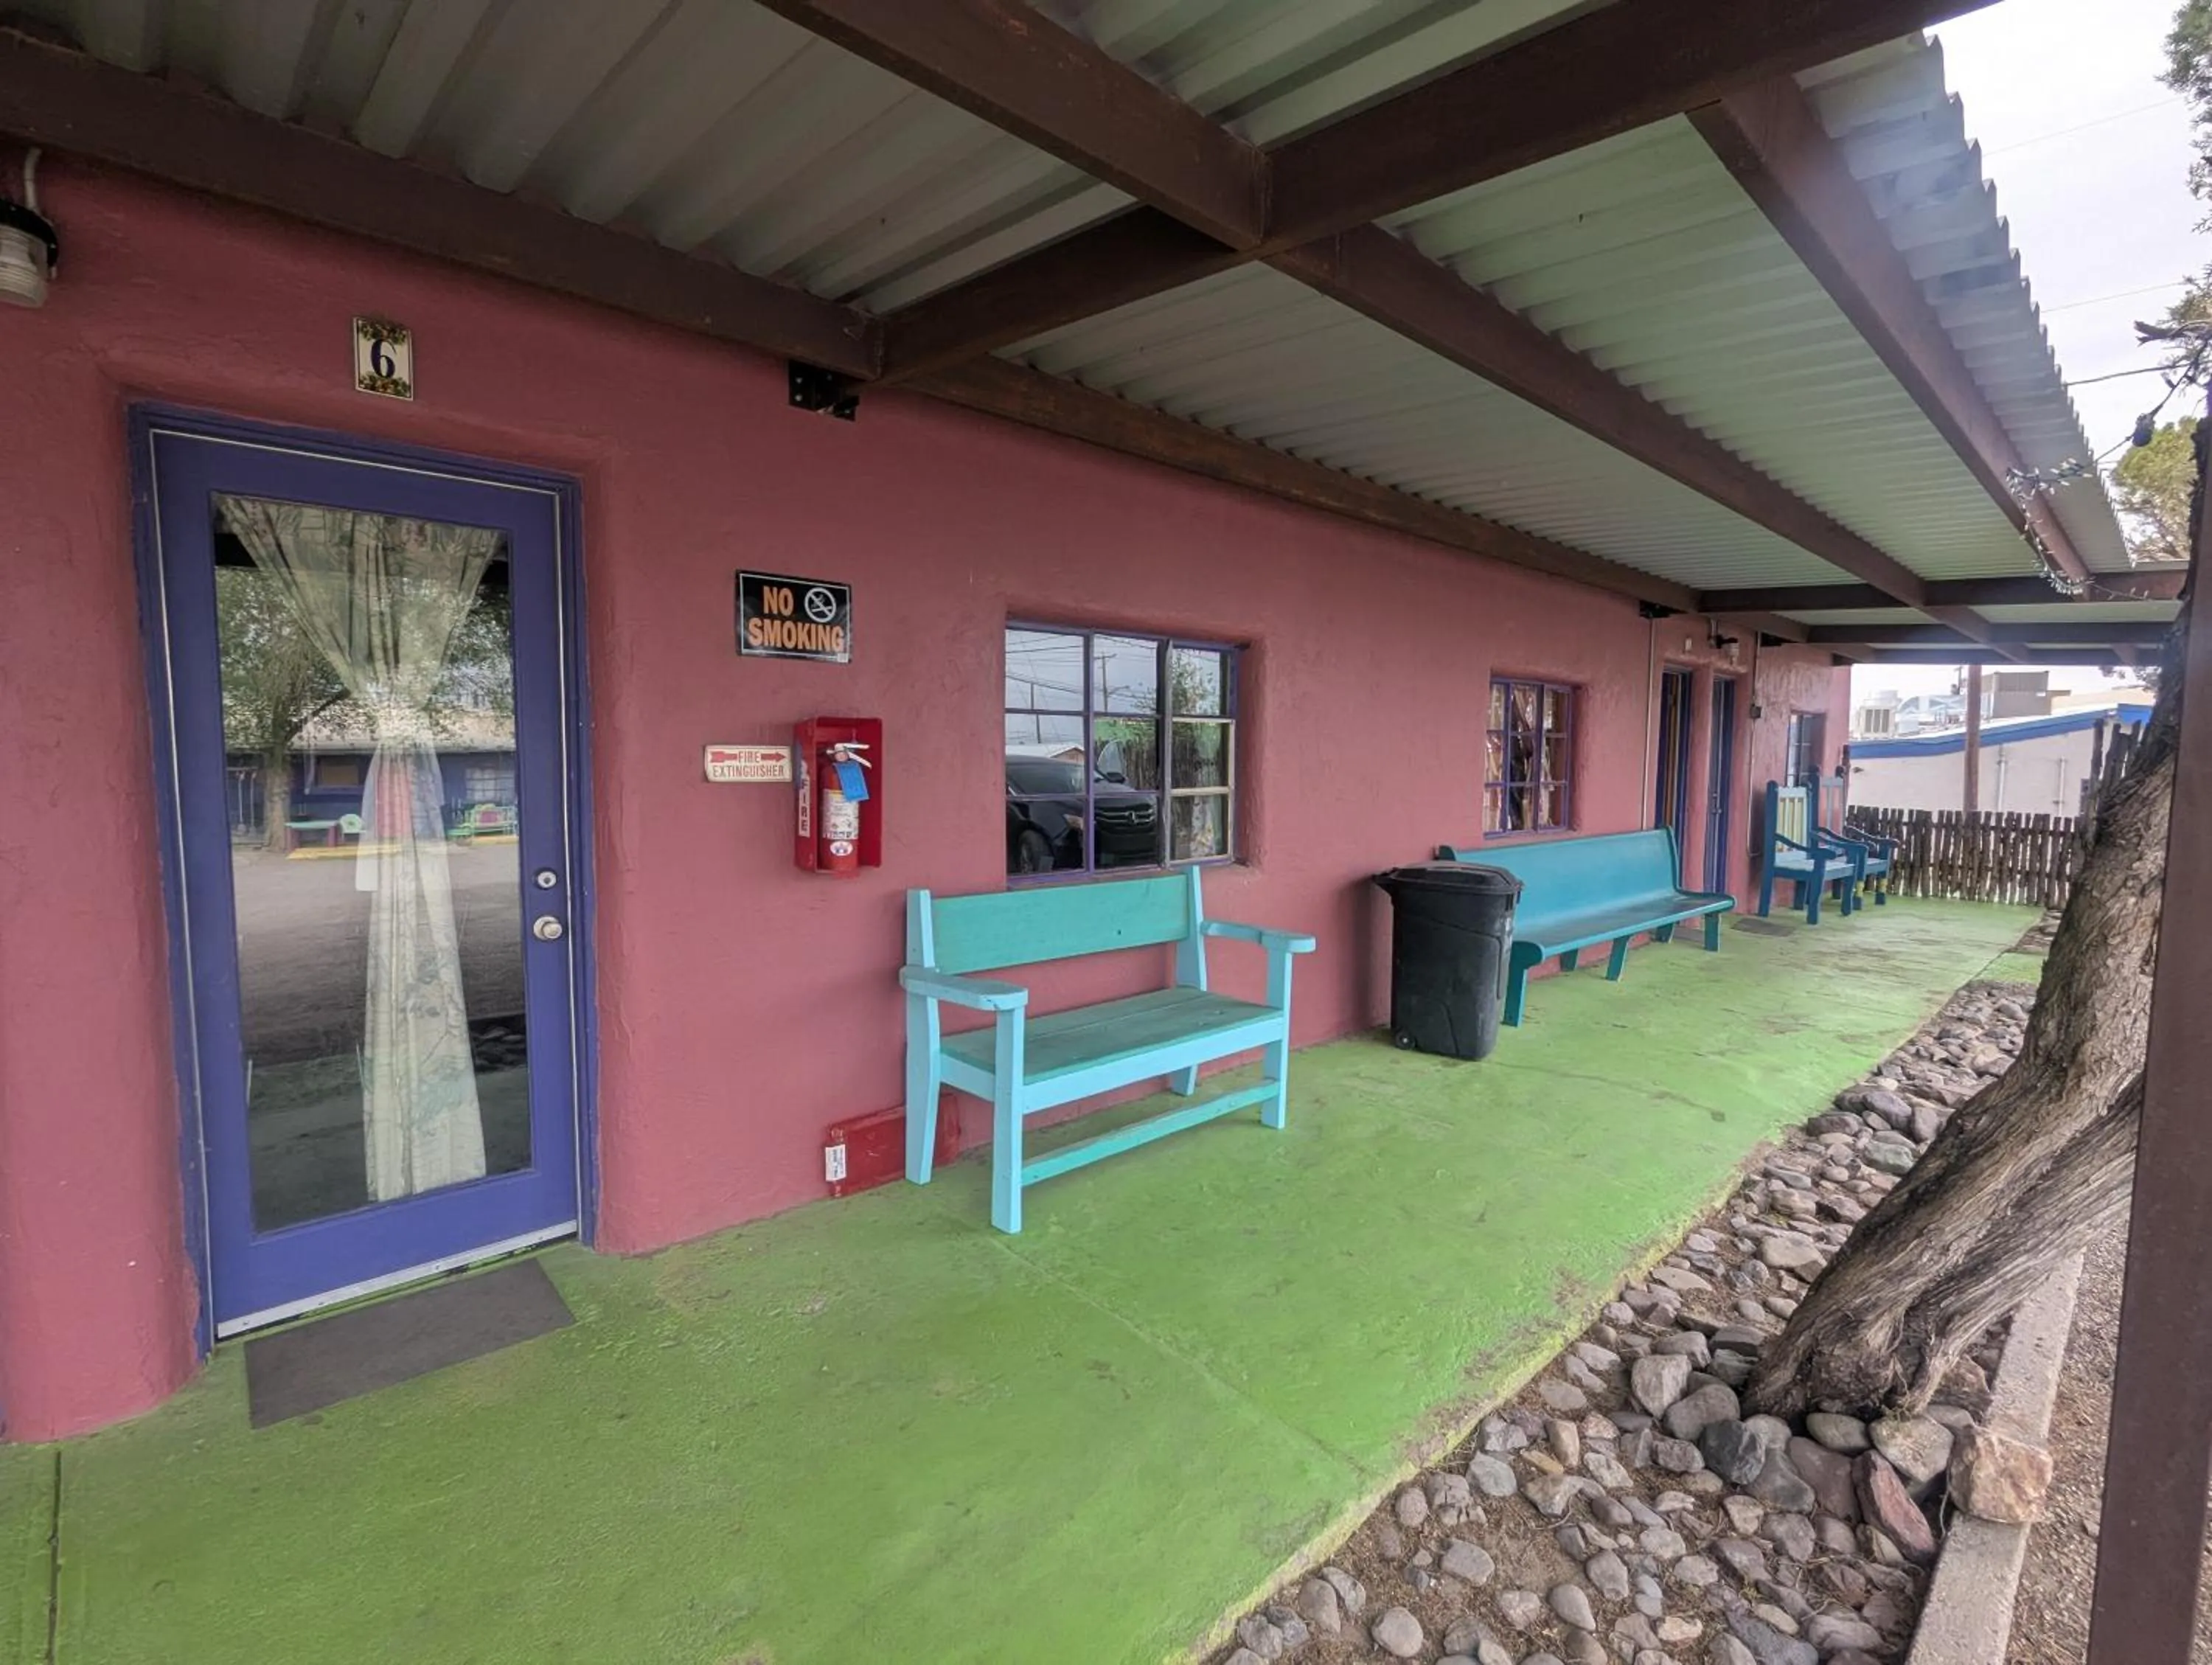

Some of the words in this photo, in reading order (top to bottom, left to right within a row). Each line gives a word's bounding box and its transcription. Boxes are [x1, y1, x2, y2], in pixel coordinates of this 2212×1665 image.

[371, 338, 397, 378] 6
[763, 585, 794, 616] NO
[748, 617, 844, 652] SMOKING
[712, 765, 785, 778] EXTINGUISHER
[738, 751, 760, 763] FIRE
